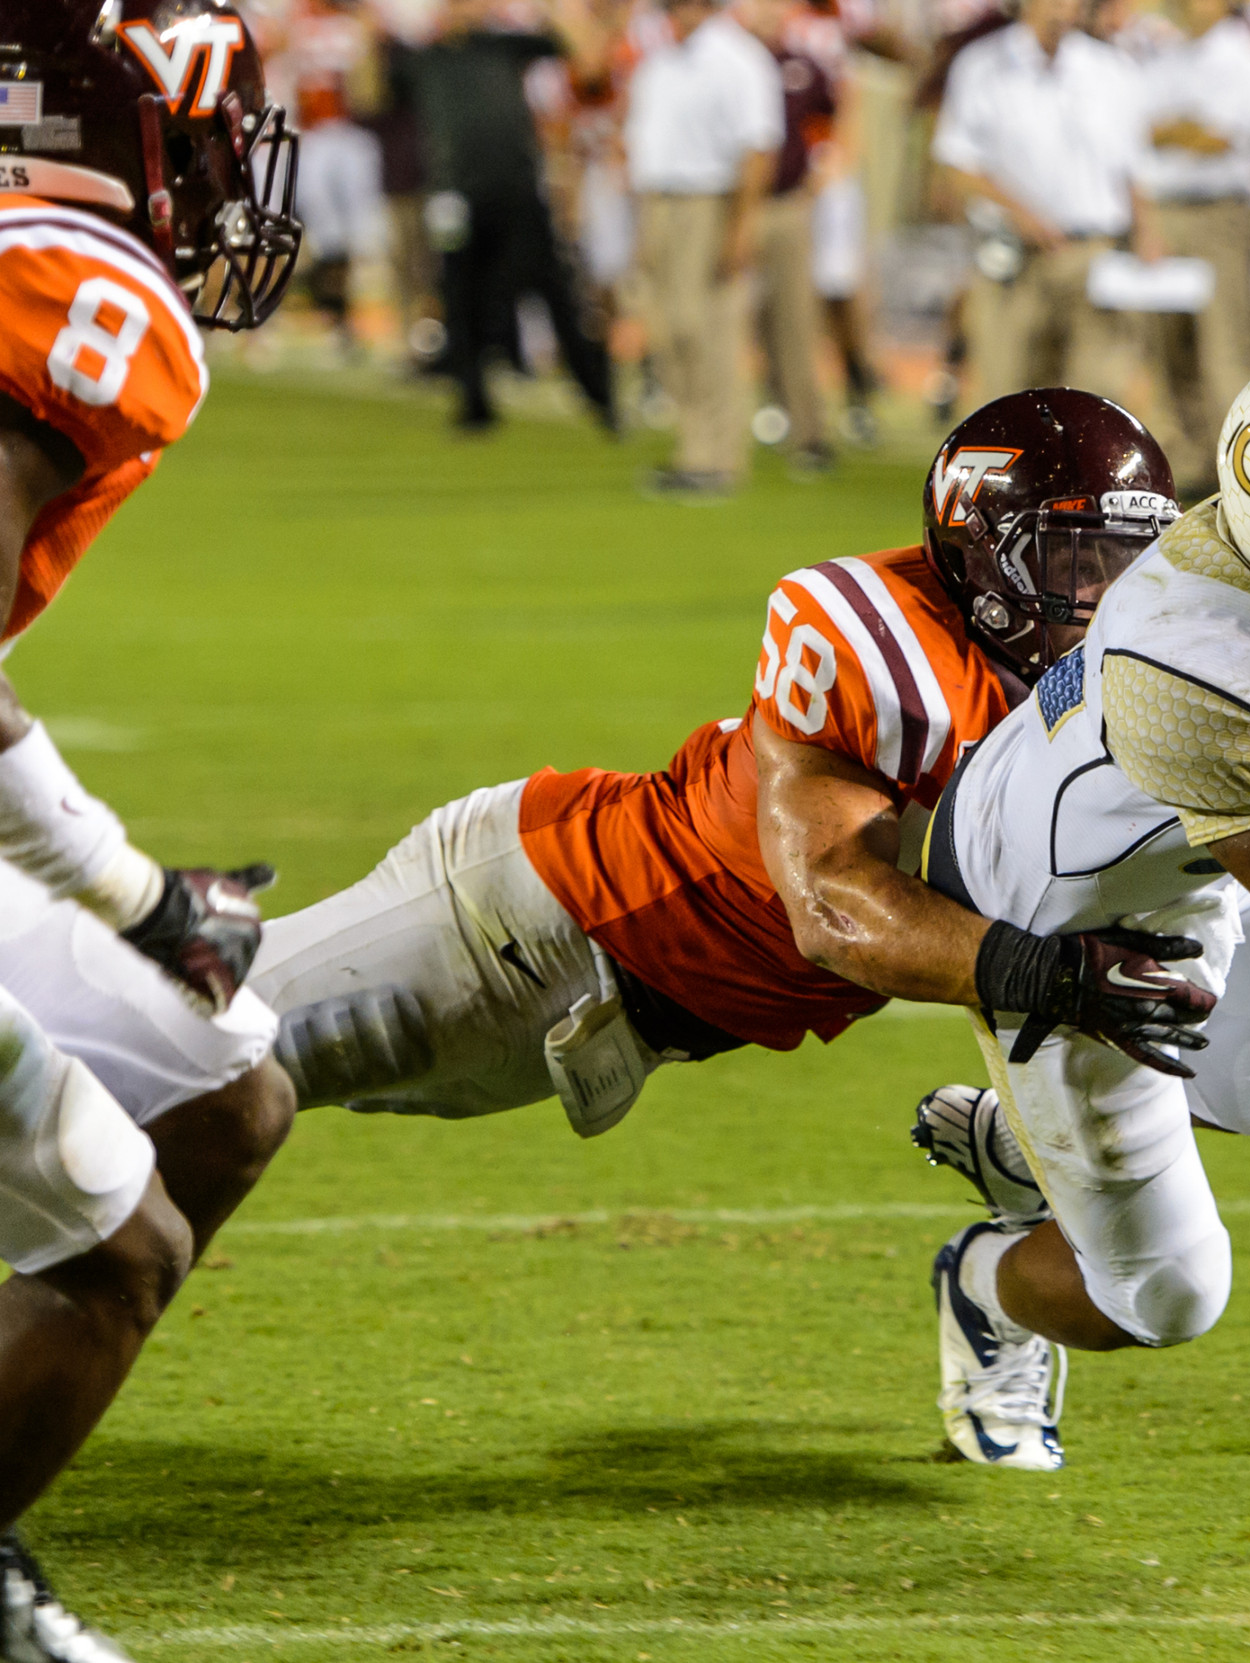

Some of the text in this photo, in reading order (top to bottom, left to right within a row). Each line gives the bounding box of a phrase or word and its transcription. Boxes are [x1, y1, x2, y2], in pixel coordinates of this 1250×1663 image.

[115, 15, 246, 118] VT
[47, 277, 151, 406] 8
[932, 446, 1025, 527] VT
[1129, 496, 1157, 510] ACC
[755, 587, 837, 735] 58
